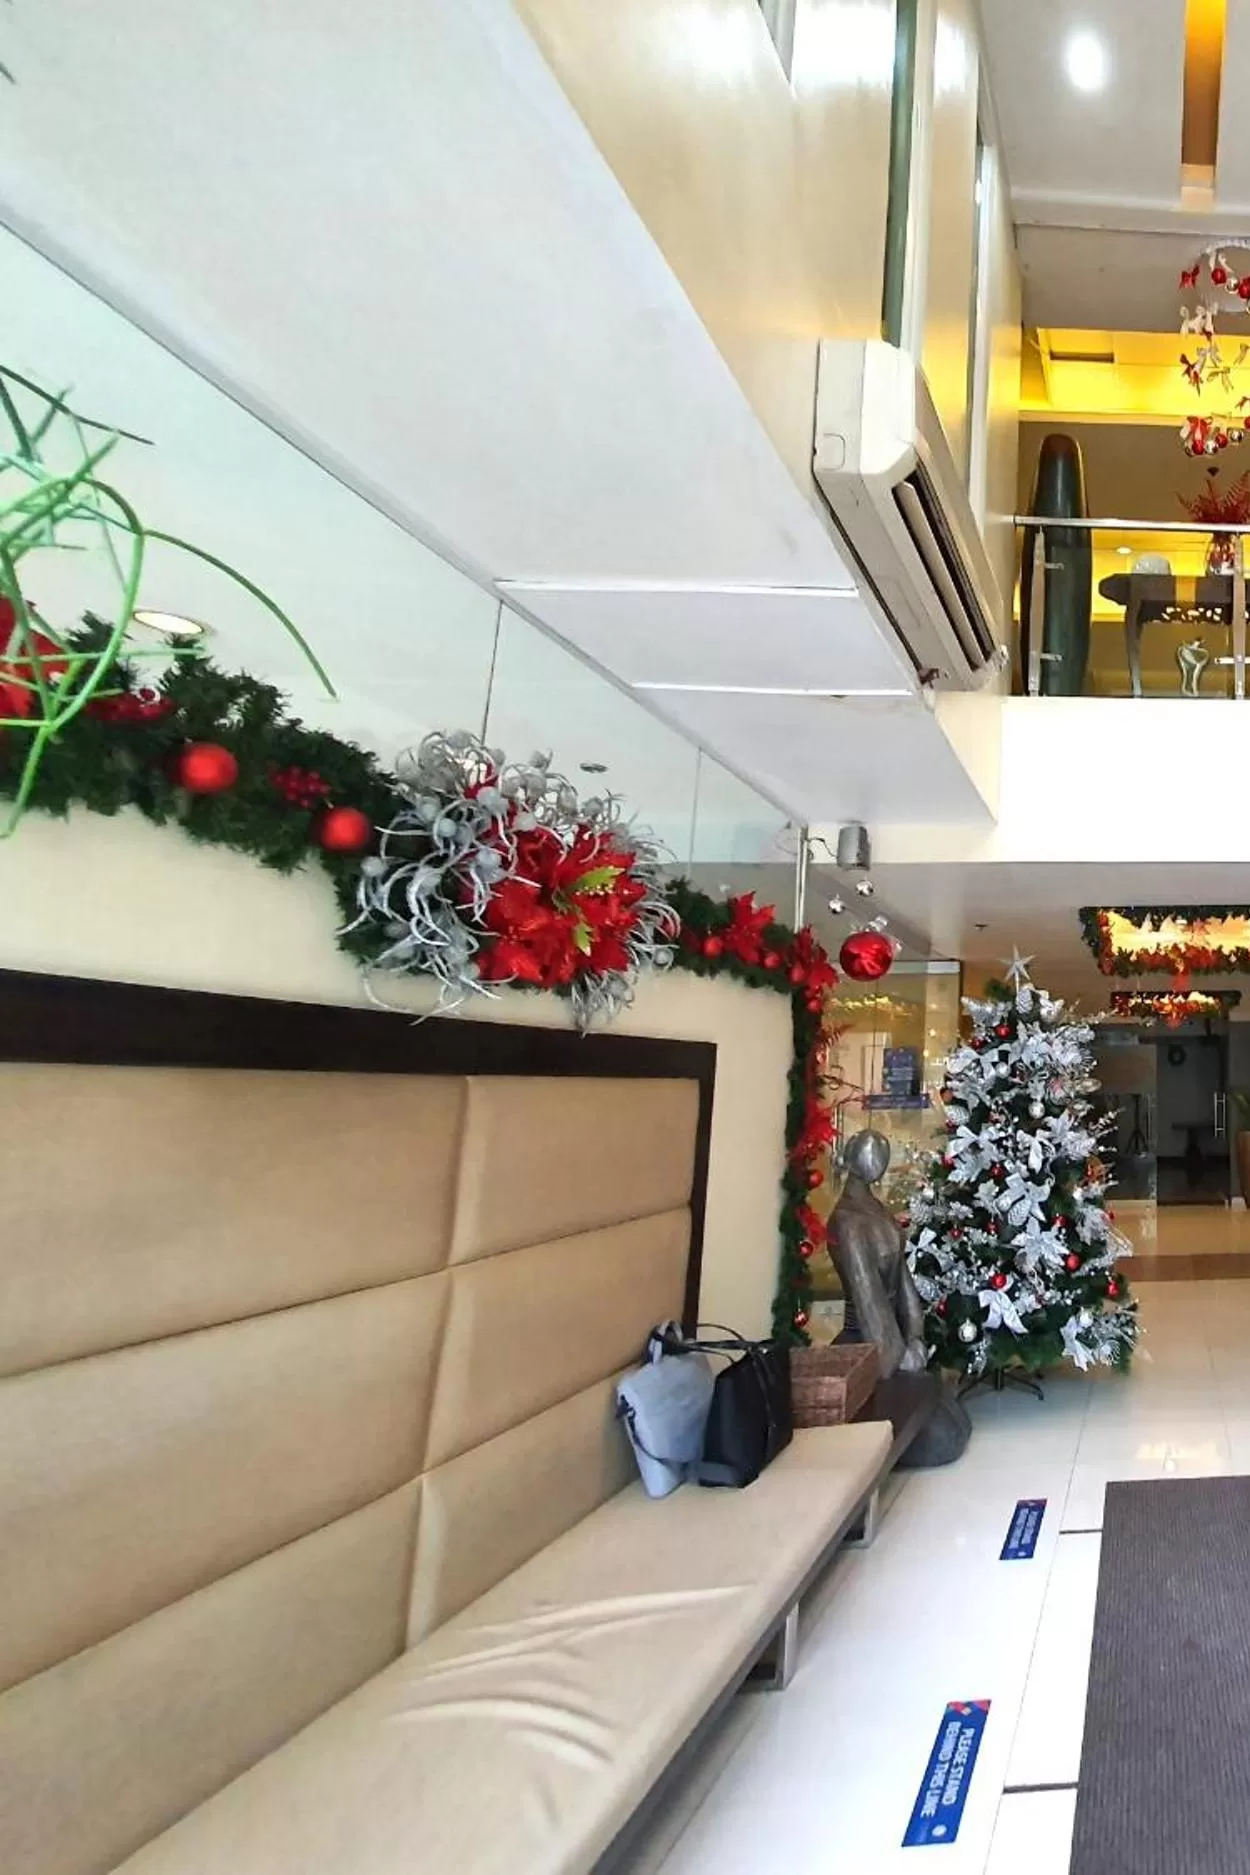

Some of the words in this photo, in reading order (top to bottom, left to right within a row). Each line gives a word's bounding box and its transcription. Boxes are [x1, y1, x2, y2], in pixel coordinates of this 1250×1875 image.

[938, 1721, 961, 1761] BEHIND
[952, 1727, 975, 1765] PLEASE
[929, 1762, 949, 1788] THIS
[942, 1767, 964, 1805] STAND
[920, 1789, 941, 1819] LINE
